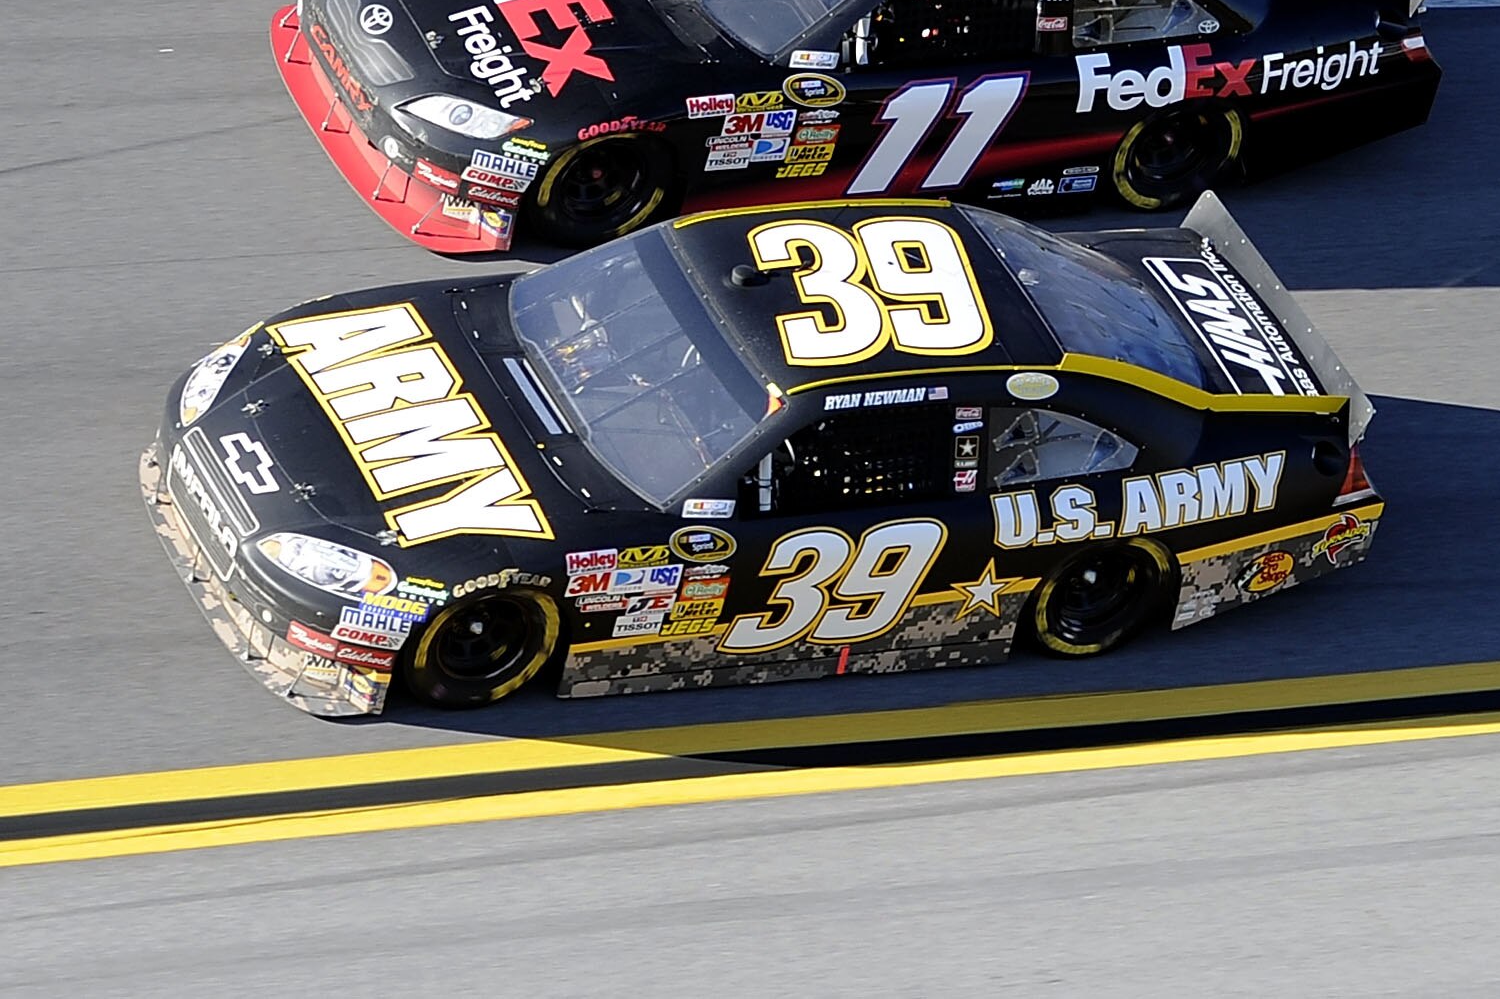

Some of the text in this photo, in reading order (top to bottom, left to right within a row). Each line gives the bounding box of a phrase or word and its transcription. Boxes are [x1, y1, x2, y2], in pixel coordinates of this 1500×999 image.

[448, 5, 534, 109] Freight
[310, 23, 374, 112] CAMRY
[1075, 38, 1385, 114] FedEx Freight
[688, 97, 734, 113] Holley
[578, 116, 666, 142] GOODYEAR
[724, 113, 765, 135] 3M
[766, 111, 794, 130] USG
[707, 136, 748, 145] LINCOLN
[847, 72, 1031, 197] 11
[798, 152, 831, 161] Meter
[801, 145, 826, 154] Auto
[474, 150, 537, 178] MAHLE
[707, 157, 748, 167] TISSOT
[776, 162, 829, 179] JEGS
[466, 169, 514, 187] COMP
[446, 197, 477, 208] WIX
[746, 216, 994, 368] 39
[1148, 259, 1286, 397] HAAS
[1223, 274, 1300, 365] Automation
[824, 387, 927, 411] RYAN NEWMAN
[265, 302, 556, 548] ARMY
[172, 443, 238, 558] IMPALA
[990, 450, 1287, 550] U.S. ARMY
[568, 552, 616, 570] Holley
[1262, 553, 1286, 565] Bass
[453, 569, 554, 598] GOODYEAR
[569, 572, 612, 595] 3M
[650, 566, 679, 586] USG
[717, 517, 949, 654] 39
[1257, 570, 1289, 585] Shops
[364, 591, 430, 615] MOOG
[577, 595, 621, 605] LINCOLN
[627, 596, 674, 614] JE
[688, 601, 714, 610] Auto
[342, 608, 412, 634] MAHLE
[684, 608, 719, 617] Meter
[337, 627, 387, 645] COMP
[616, 622, 660, 632] TISSOT
[660, 618, 718, 635] JEGS
[308, 655, 337, 669] WIX
[336, 647, 392, 667] Edelbrock
